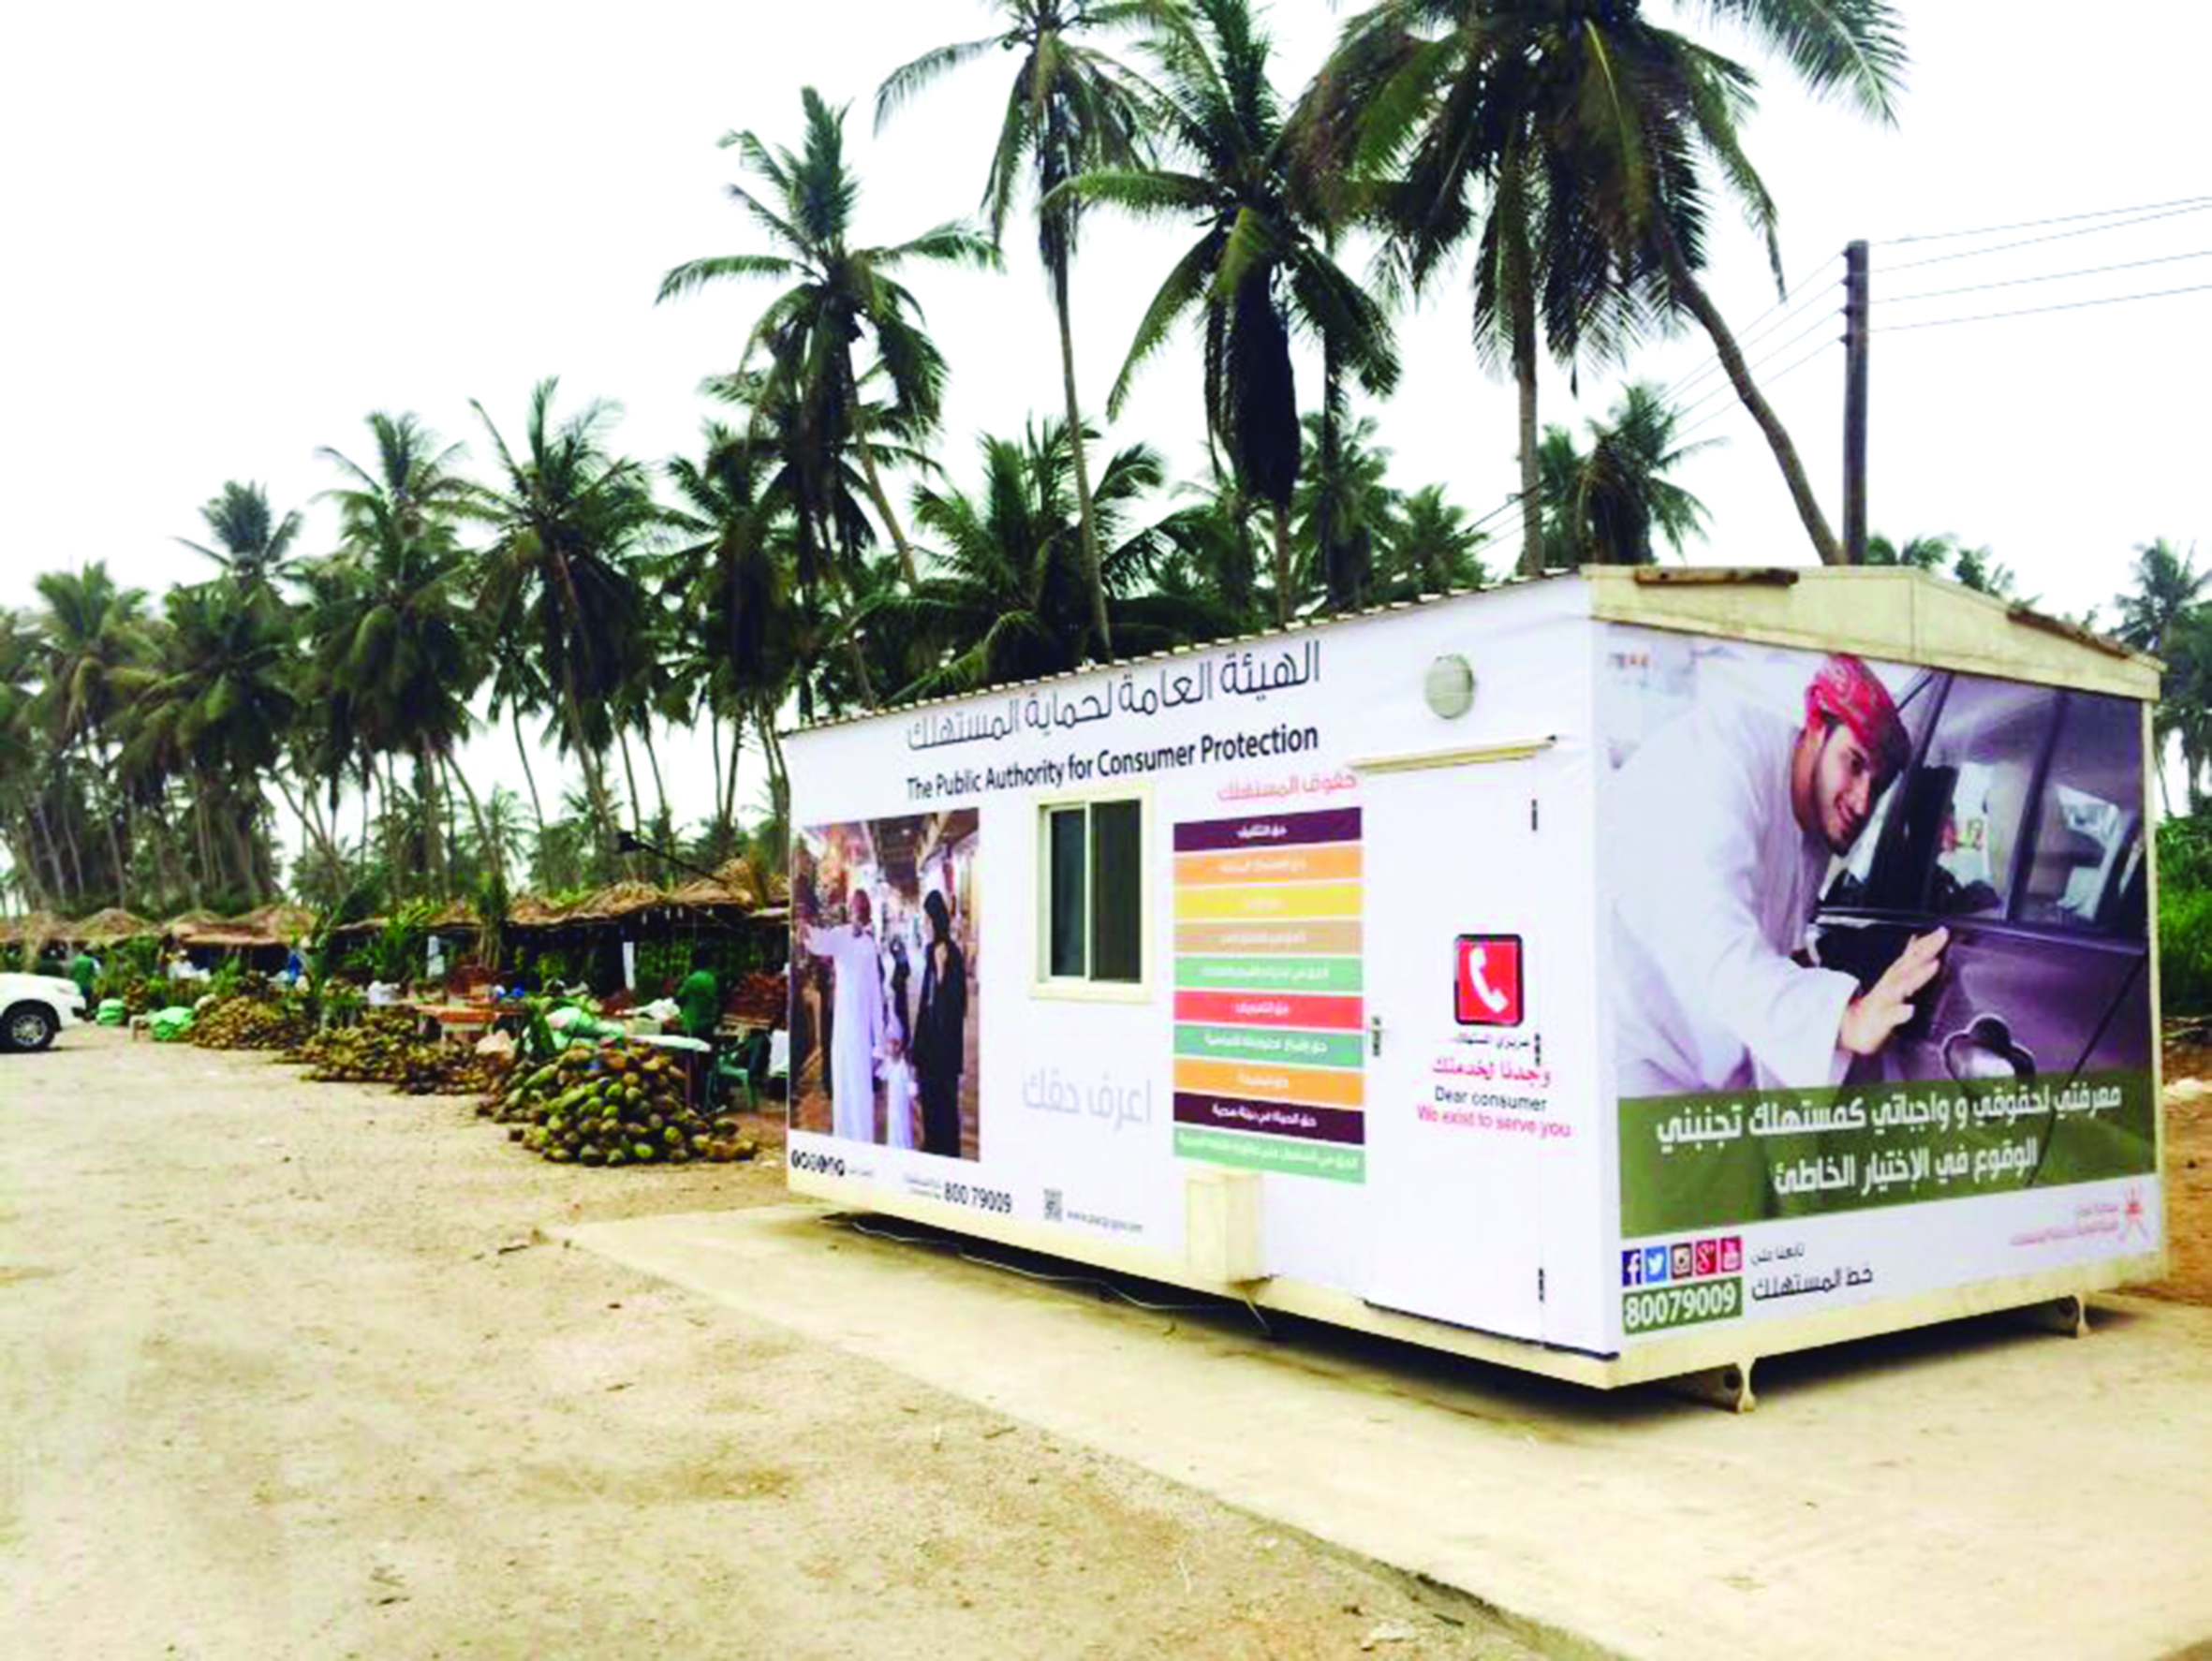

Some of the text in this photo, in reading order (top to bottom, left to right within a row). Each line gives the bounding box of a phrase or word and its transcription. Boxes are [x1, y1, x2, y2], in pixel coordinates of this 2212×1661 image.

[907, 640, 1320, 750] الهيئة العامة لحماية المستهلك
[907, 723, 1320, 800] The Public Authority for Consumer Protection
[1086, 1069, 1152, 1134] اعرف
[1435, 1084, 1548, 1112] Dear consumer
[1657, 1080, 2122, 1154] معرفتي لحقوقي و واجباتي كمستهلك تجنبني
[1416, 1104, 1571, 1139] We exist to serve you
[1775, 1153, 1856, 1195] الخاطئ
[1935, 1143, 1969, 1184] في
[1974, 1136, 2038, 1183] الوقوع
[944, 1182, 968, 1206] 800
[970, 1185, 1013, 1214] 79009
[1750, 1260, 1874, 1301] خط المستهلك
[1624, 1281, 1737, 1329] 80079009
